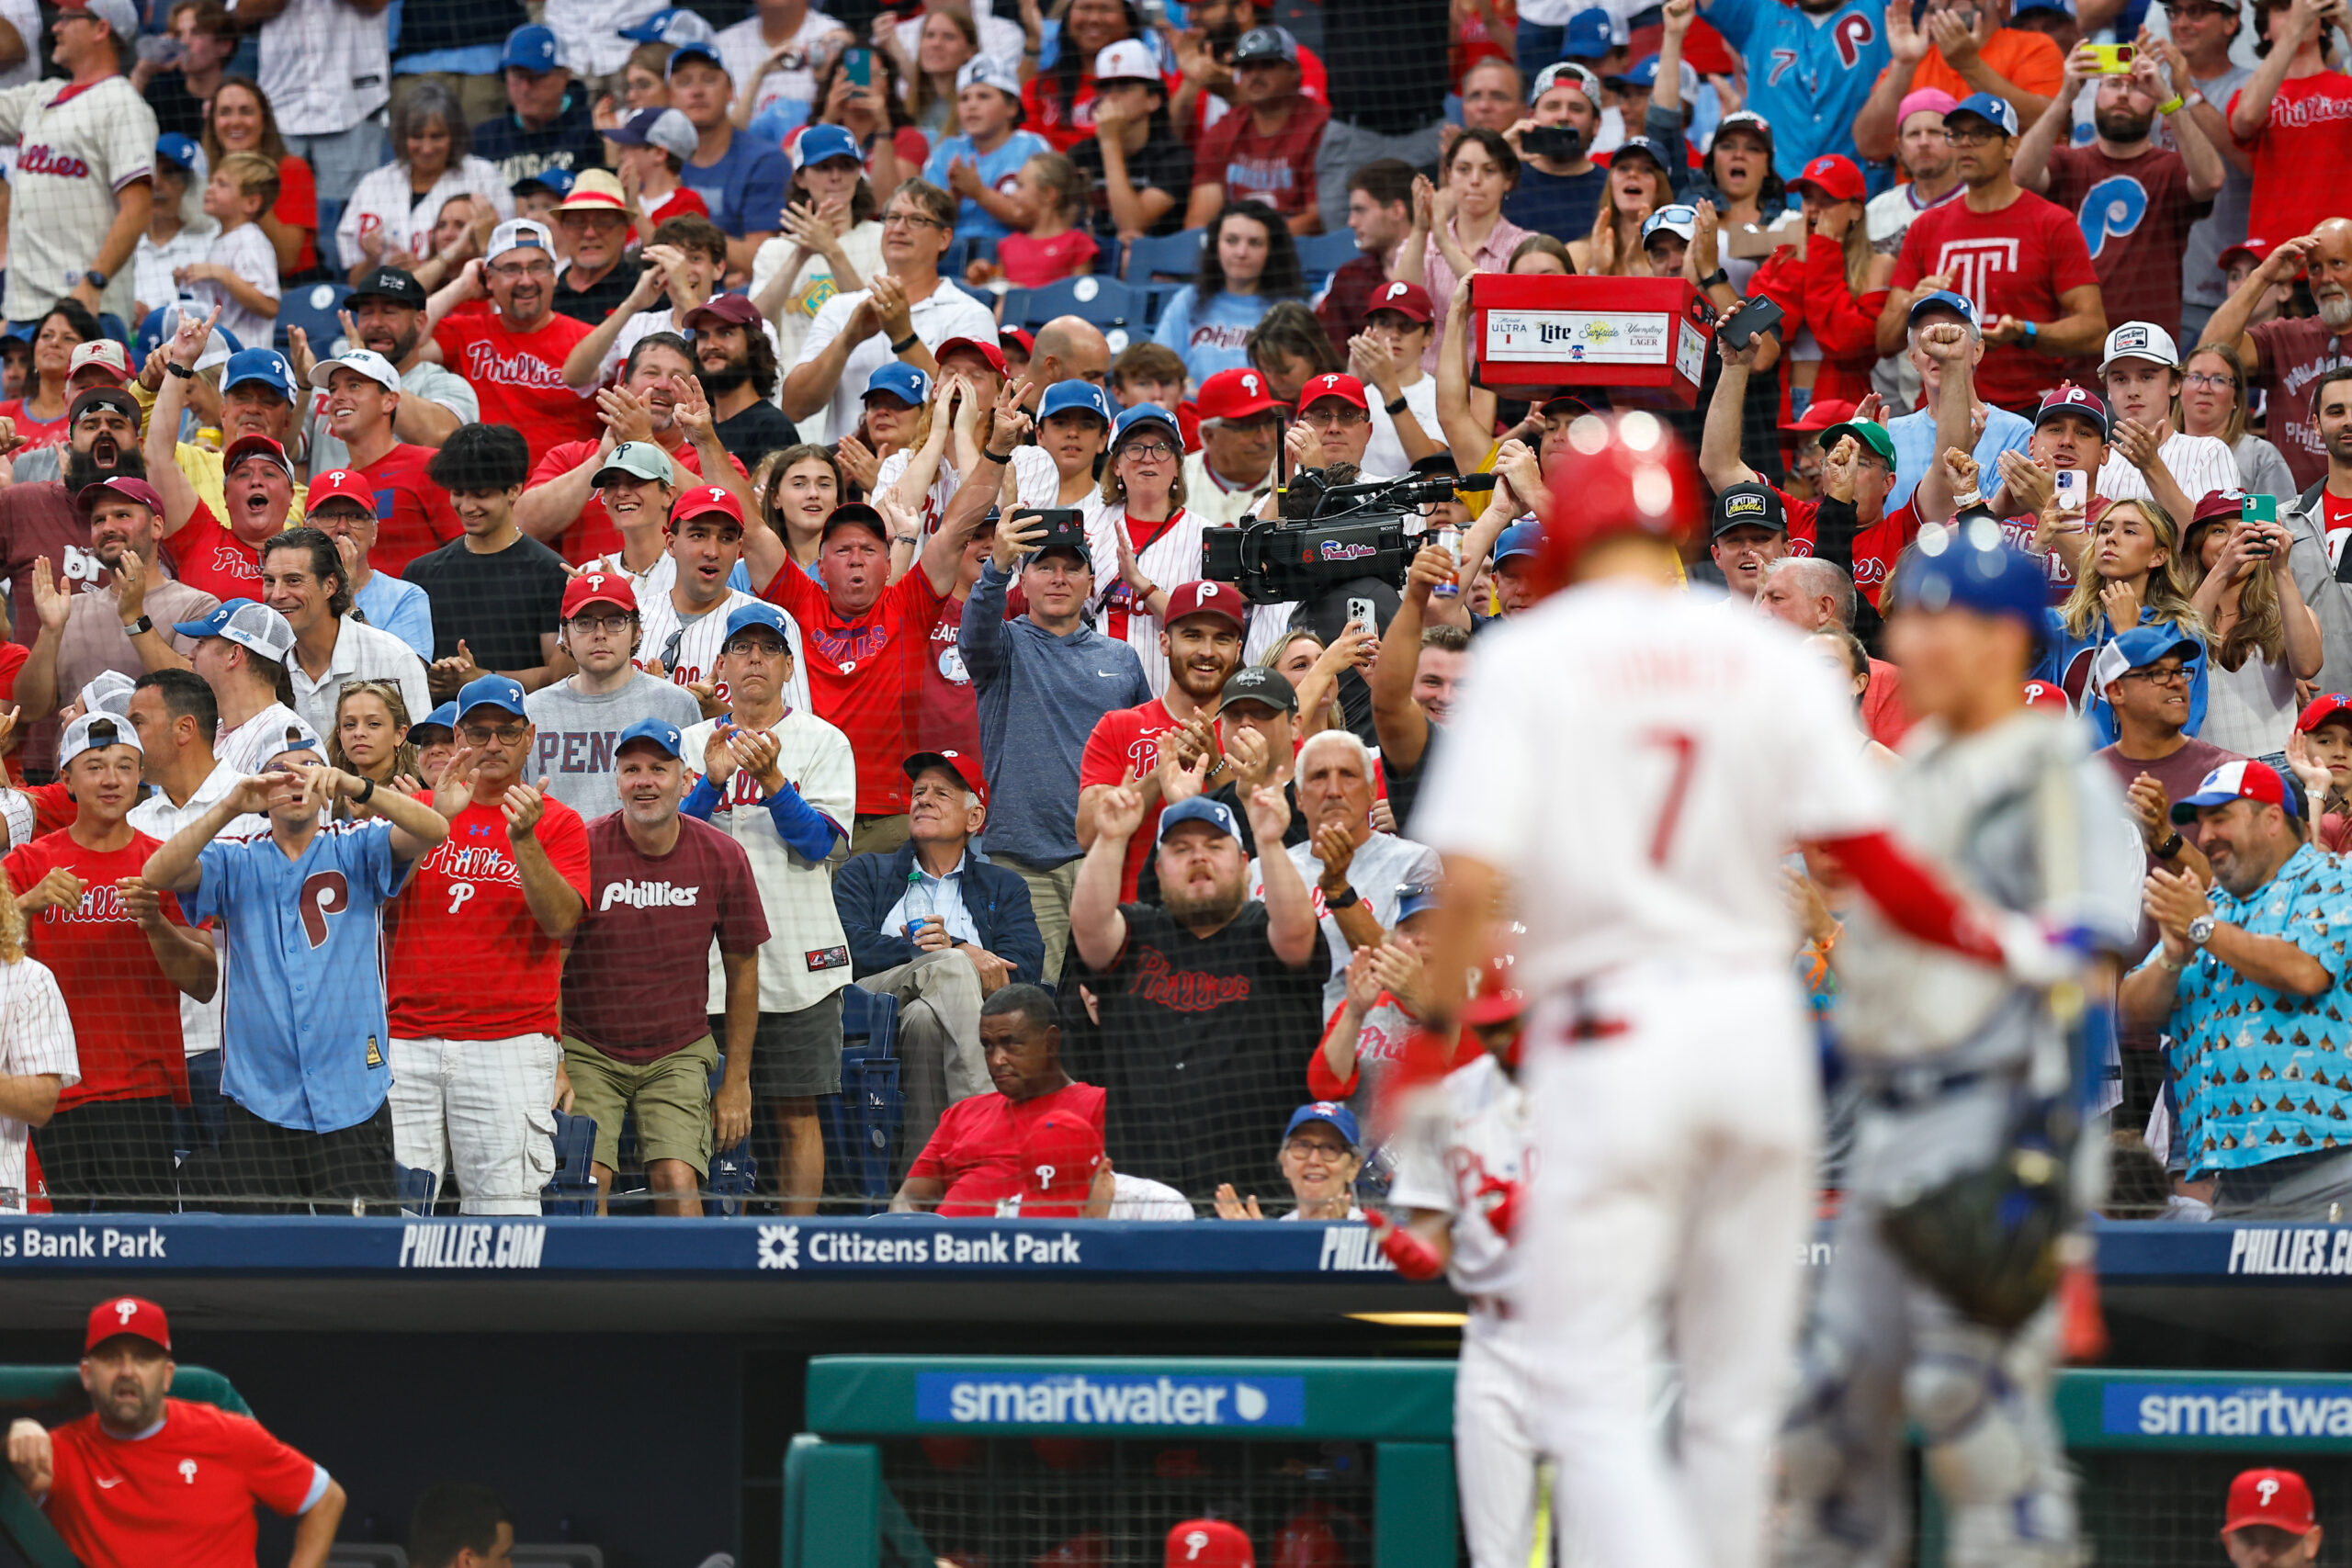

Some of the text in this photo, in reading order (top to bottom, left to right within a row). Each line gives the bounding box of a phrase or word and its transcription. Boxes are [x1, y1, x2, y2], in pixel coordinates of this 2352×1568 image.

[1835, 11, 1875, 69] P
[1768, 49, 1797, 86] 7
[2076, 174, 2149, 260] P
[1385, 281, 1408, 301] P
[1935, 236, 2019, 324] T
[1491, 323, 1527, 333] ULTRA
[1540, 323, 1571, 344] Lite
[1579, 322, 1620, 340] Surfside
[1630, 338, 1657, 346] LAGER
[272, 359, 284, 374] P
[910, 374, 922, 389] P
[1241, 374, 1259, 397] P
[1323, 375, 1340, 389] P
[2065, 388, 2087, 404] P
[616, 443, 632, 459] P
[329, 471, 346, 488] P
[708, 487, 726, 502] P
[1302, 549, 1314, 563] 6
[587, 575, 605, 592] P
[1195, 581, 1219, 608] P
[212, 610, 229, 623] P
[775, 616, 786, 628] P
[509, 689, 520, 702] P
[2024, 683, 2044, 705] P
[667, 730, 678, 743] P
[537, 731, 620, 774] PEN
[1638, 726, 1698, 871] 7
[1215, 807, 1227, 822] P
[299, 869, 349, 950] P
[447, 883, 475, 914] P
[1128, 944, 1252, 1012] Phillies
[1035, 1165, 1056, 1190] P
[23, 1226, 96, 1258] Bank
[103, 1226, 166, 1258] Park
[399, 1224, 546, 1268] PHILLIES.COM
[808, 1231, 1081, 1263] Citizens Bank Park
[116, 1298, 137, 1324] P
[950, 1375, 1227, 1424] smartwater
[178, 1458, 197, 1483] P
[2256, 1477, 2279, 1506] P
[1183, 1530, 1207, 1561] P
